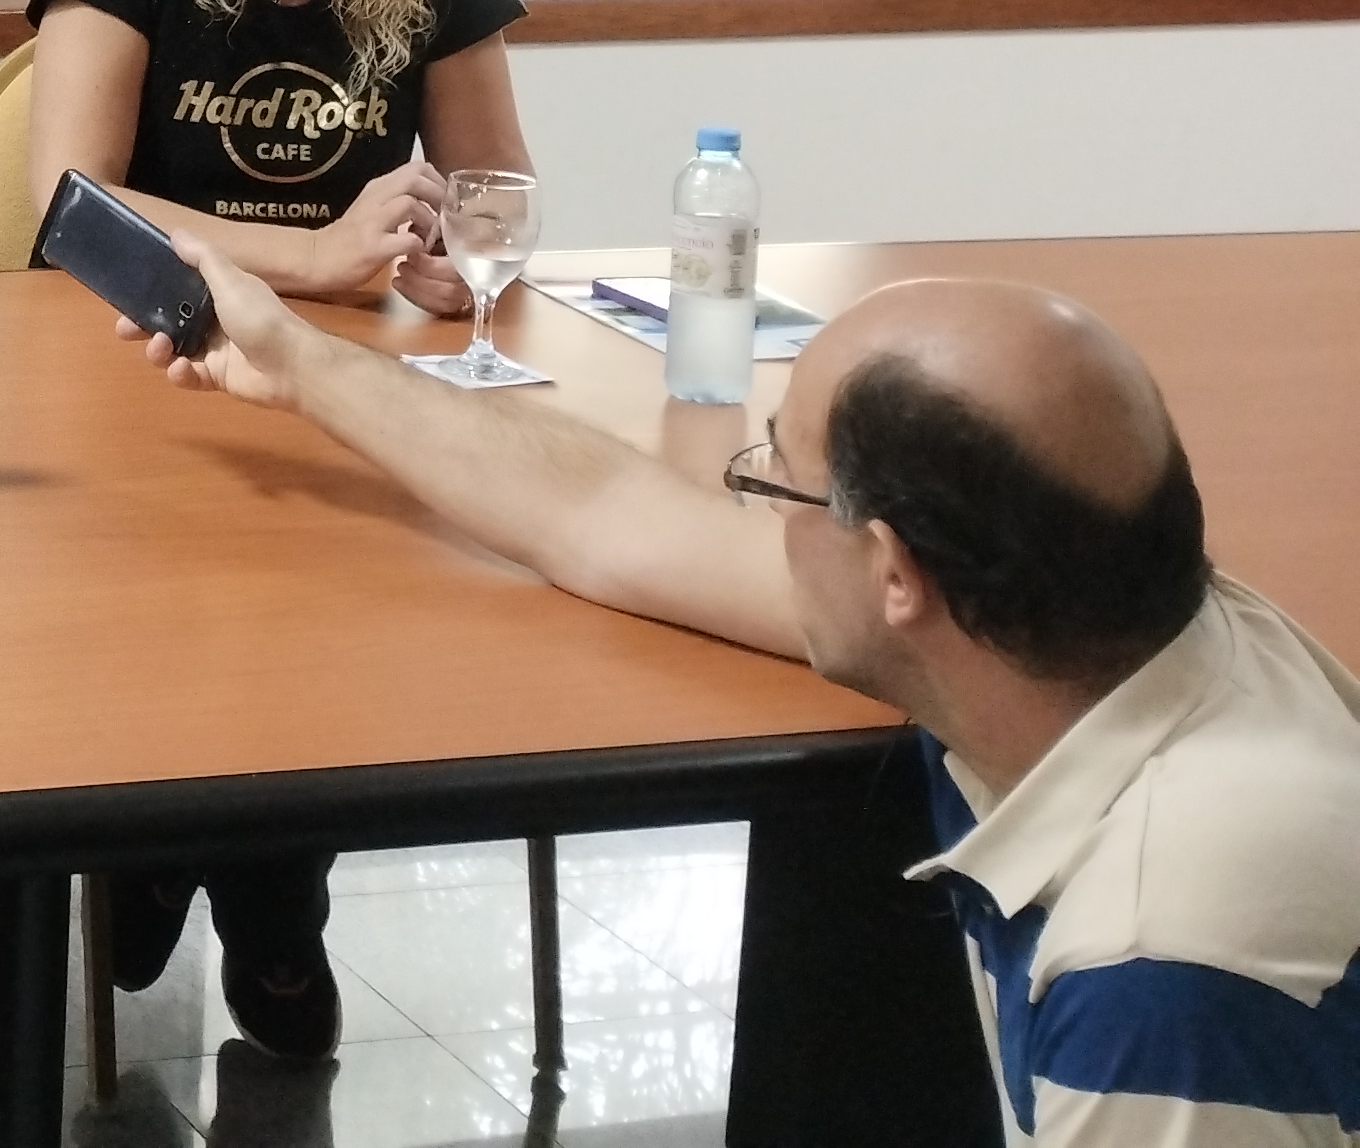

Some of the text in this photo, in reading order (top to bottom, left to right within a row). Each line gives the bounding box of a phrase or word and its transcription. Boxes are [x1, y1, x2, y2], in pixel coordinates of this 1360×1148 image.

[174, 79, 389, 140] Hard Rock
[256, 142, 313, 162] CAFE
[214, 199, 331, 220] BARCELONA
